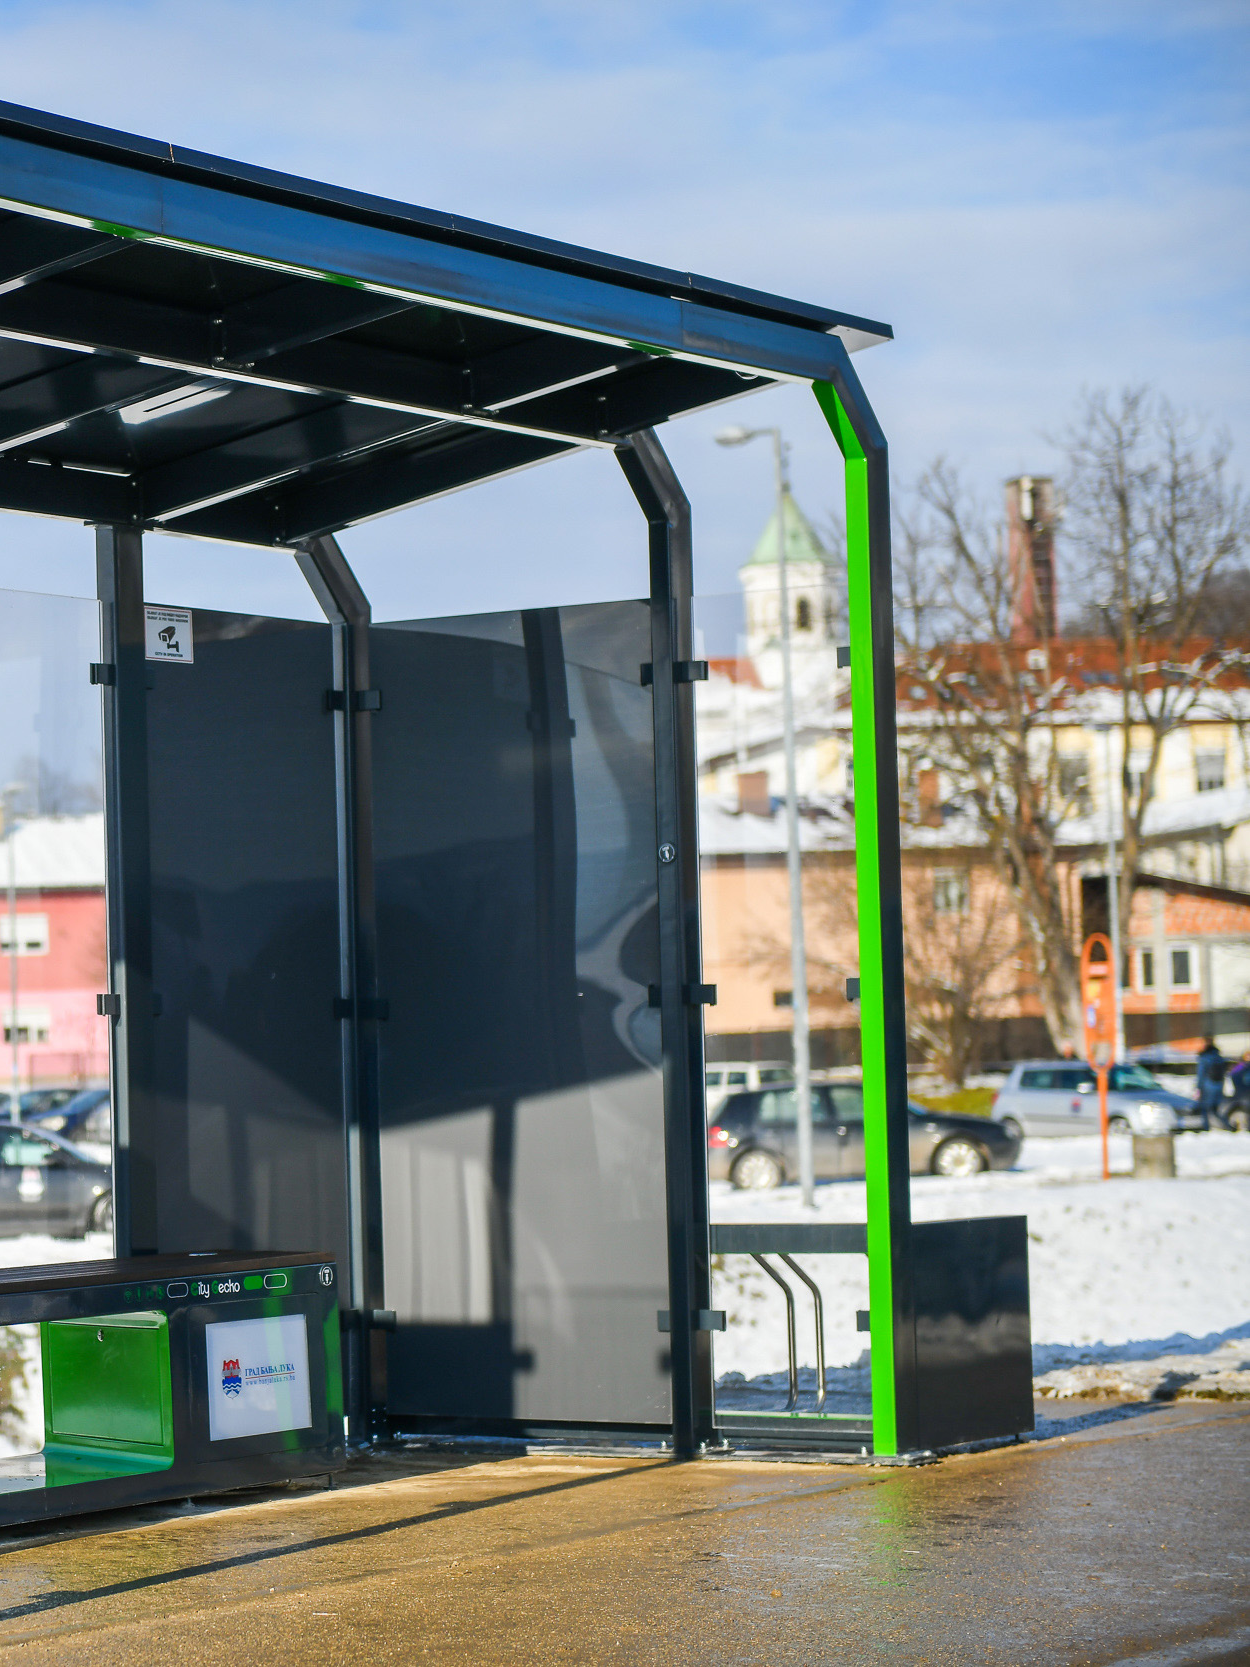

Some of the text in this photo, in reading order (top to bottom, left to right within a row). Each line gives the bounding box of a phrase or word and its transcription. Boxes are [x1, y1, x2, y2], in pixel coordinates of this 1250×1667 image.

[190, 1279, 240, 1298] City Gecko
[245, 1367, 260, 1376] ГРАД
